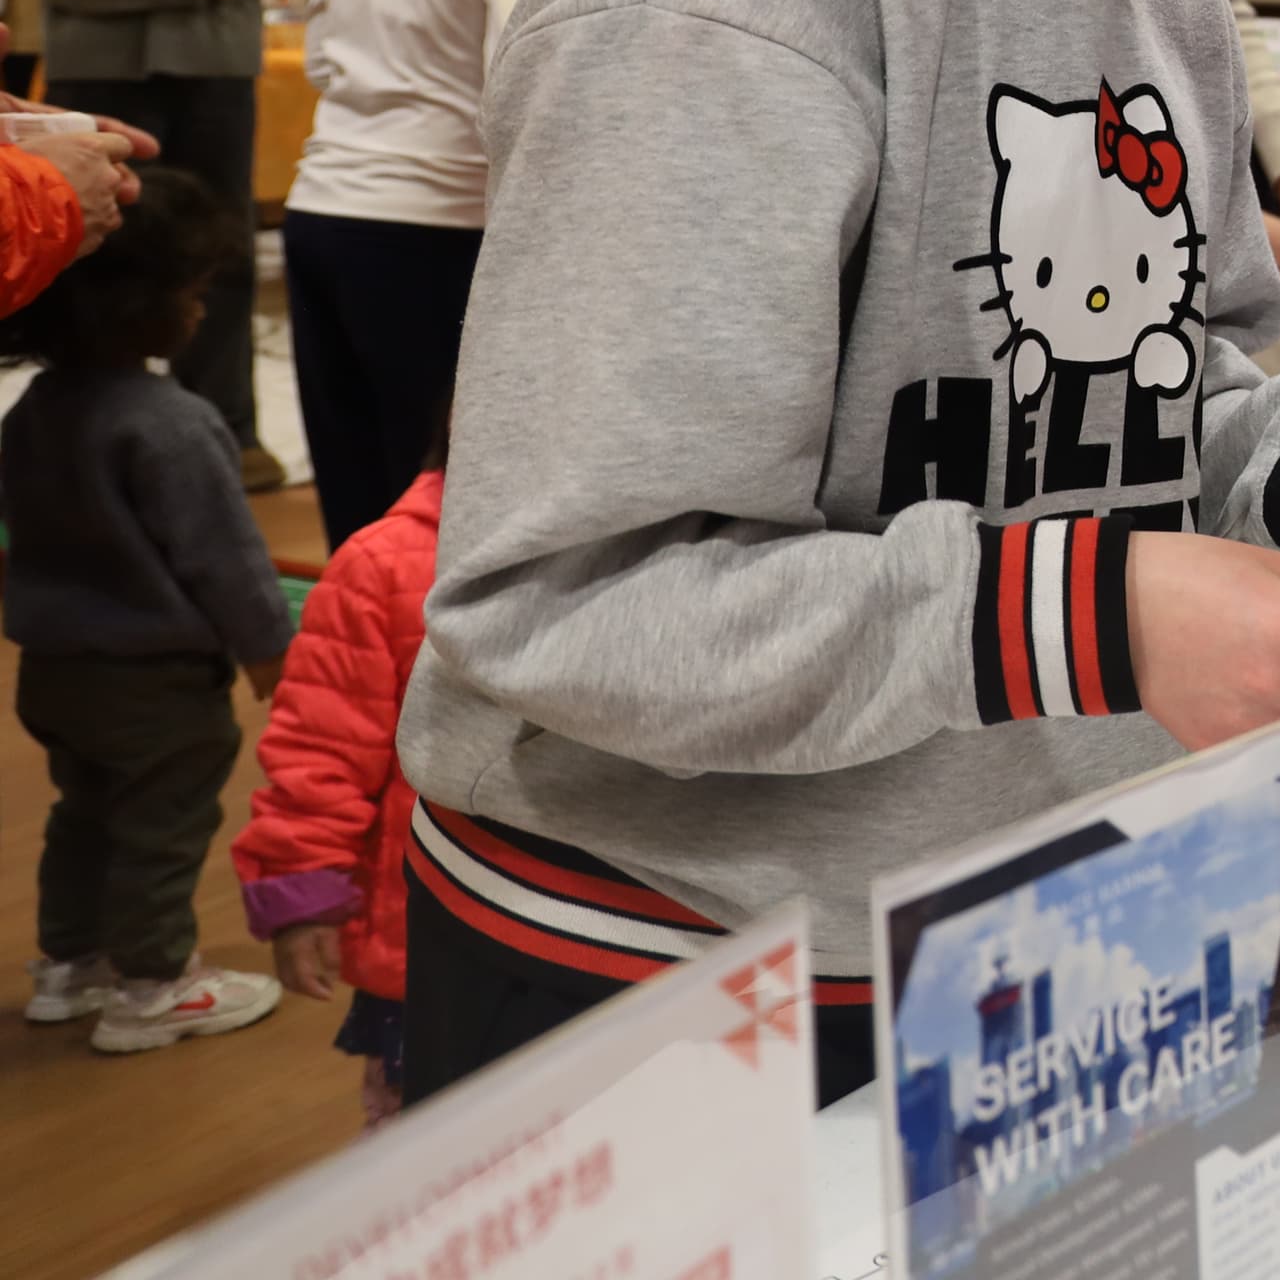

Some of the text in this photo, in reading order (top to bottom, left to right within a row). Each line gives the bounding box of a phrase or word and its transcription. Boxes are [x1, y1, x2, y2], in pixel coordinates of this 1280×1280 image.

[876, 368, 1203, 516] HELL
[968, 972, 1178, 1122] SERVICE
[973, 1090, 1107, 1198] WITH
[1118, 1013, 1238, 1115] CARE
